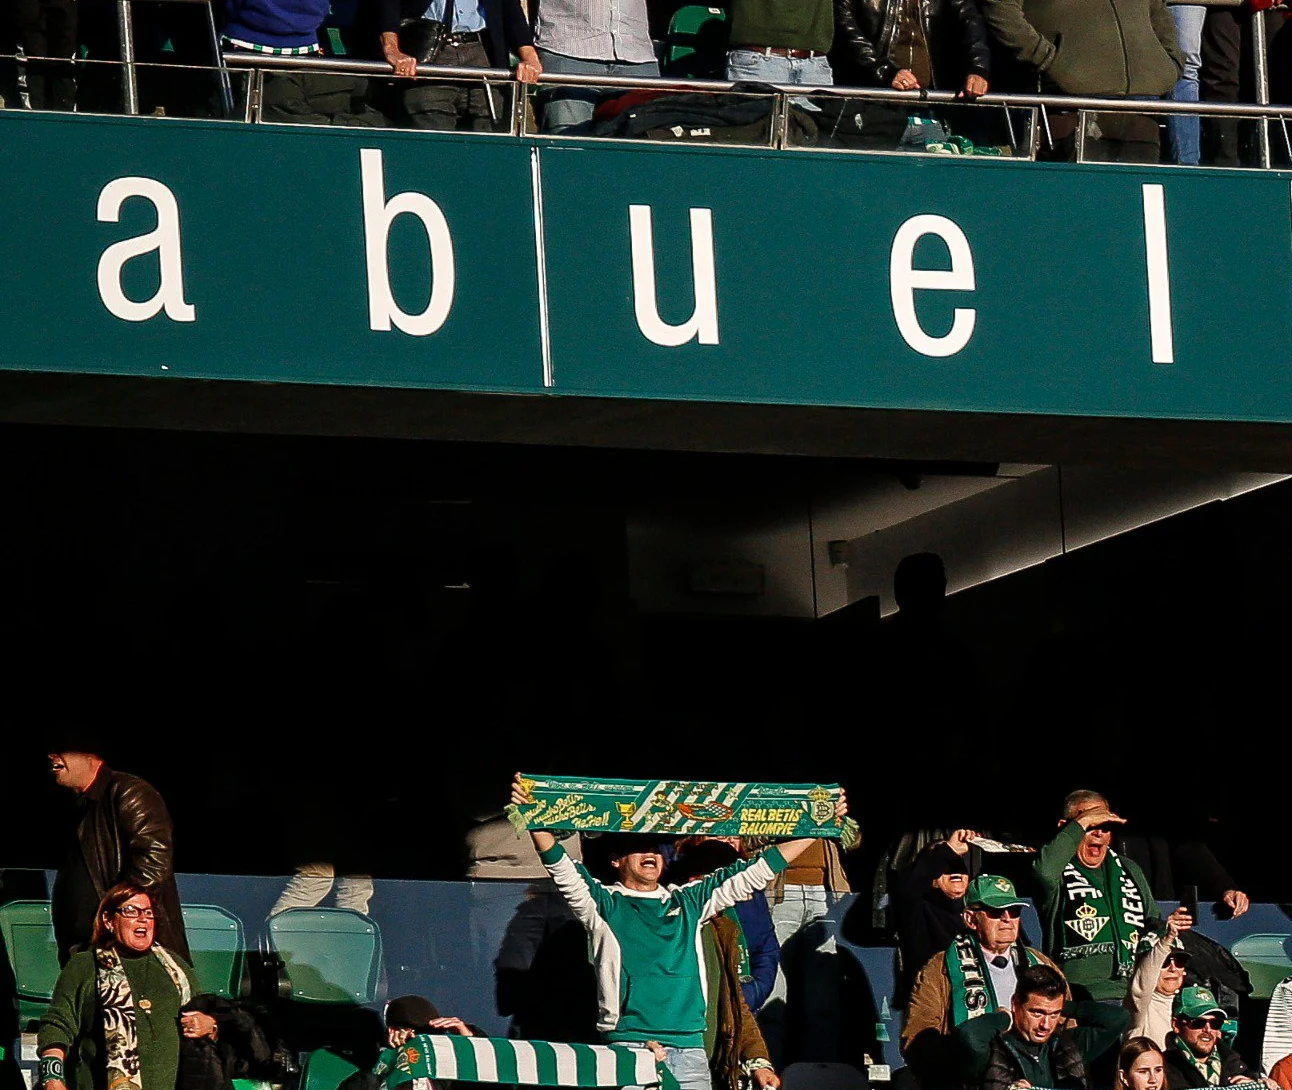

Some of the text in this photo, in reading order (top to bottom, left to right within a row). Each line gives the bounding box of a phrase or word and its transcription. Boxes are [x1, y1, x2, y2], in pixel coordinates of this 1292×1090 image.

[741, 809, 802, 822] REAL BETIS
[740, 822, 797, 835] BALOMPIE
